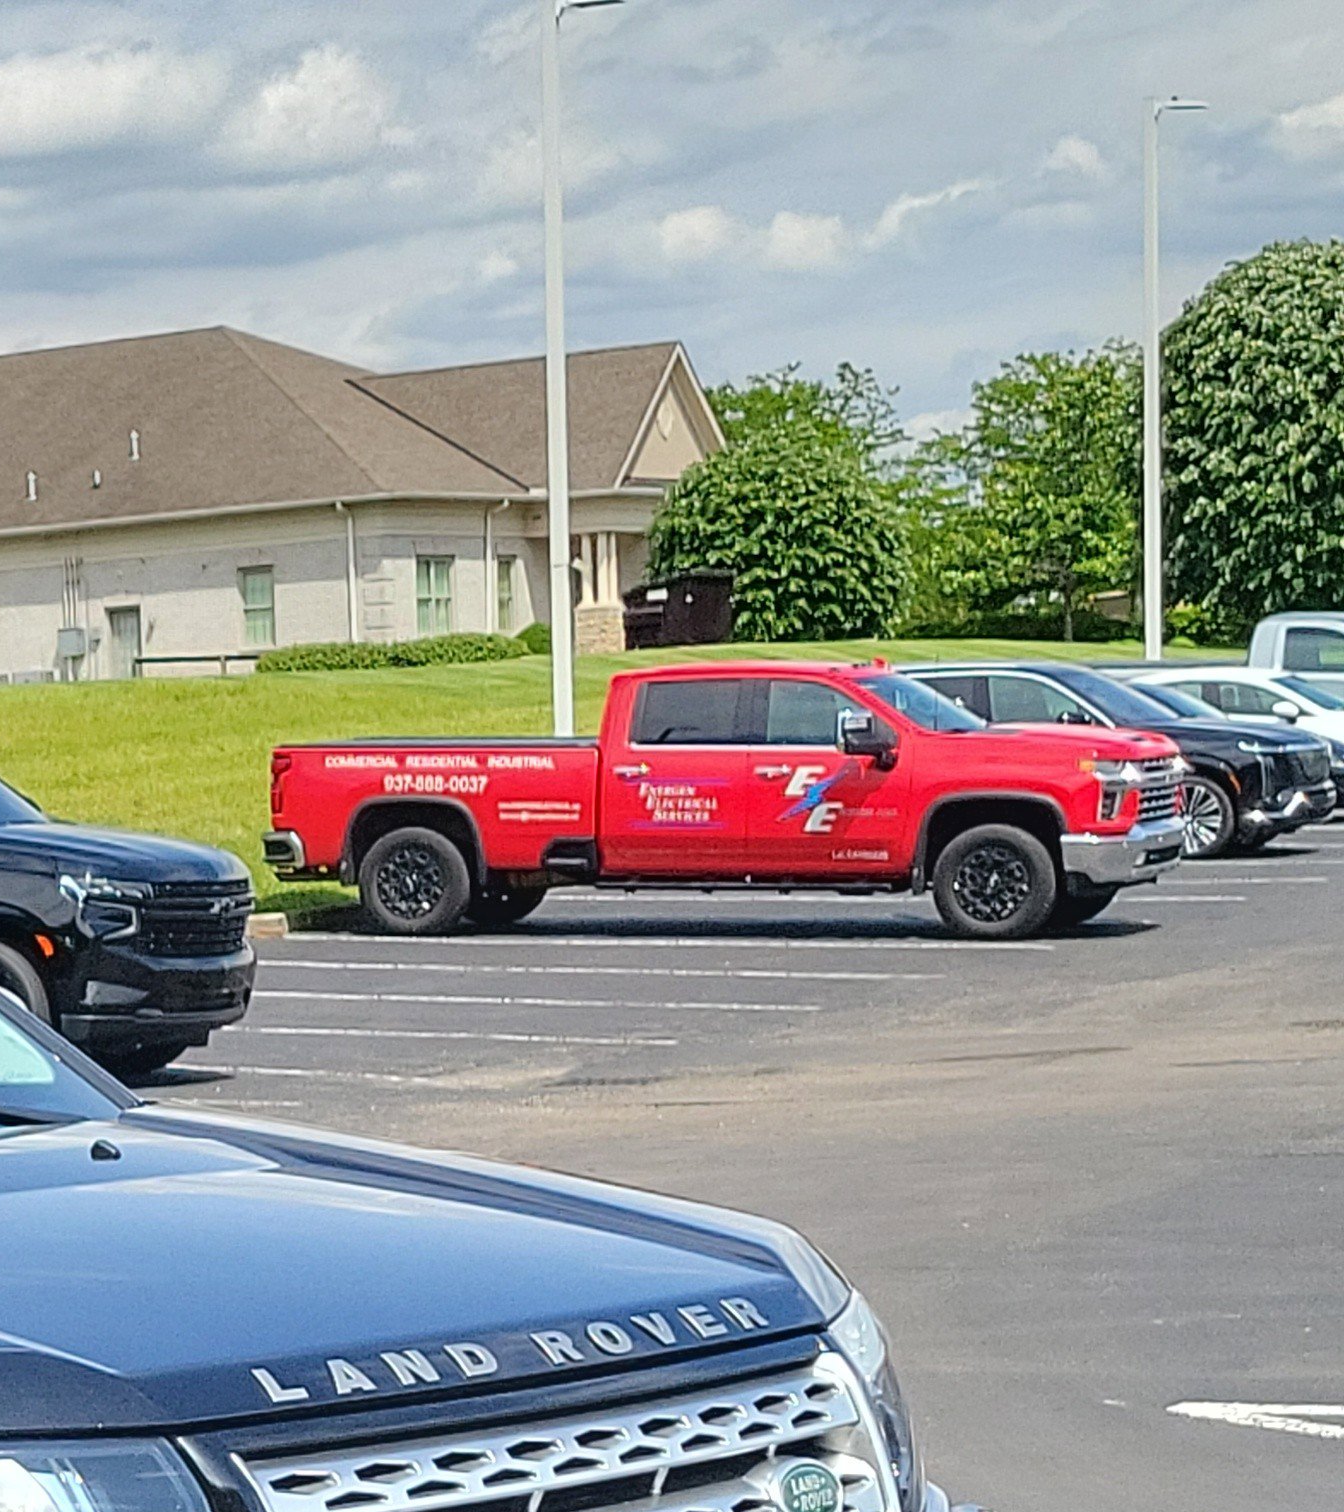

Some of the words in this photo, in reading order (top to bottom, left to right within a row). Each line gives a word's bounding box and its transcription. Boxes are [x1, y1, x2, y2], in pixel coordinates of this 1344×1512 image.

[325, 755, 399, 768] COMMERCIAL
[406, 755, 479, 769] RESIDENTIAL
[487, 756, 555, 770] INDUSTRIAL
[250, 1342, 499, 1403] LAND
[529, 1297, 770, 1366] ROVER
